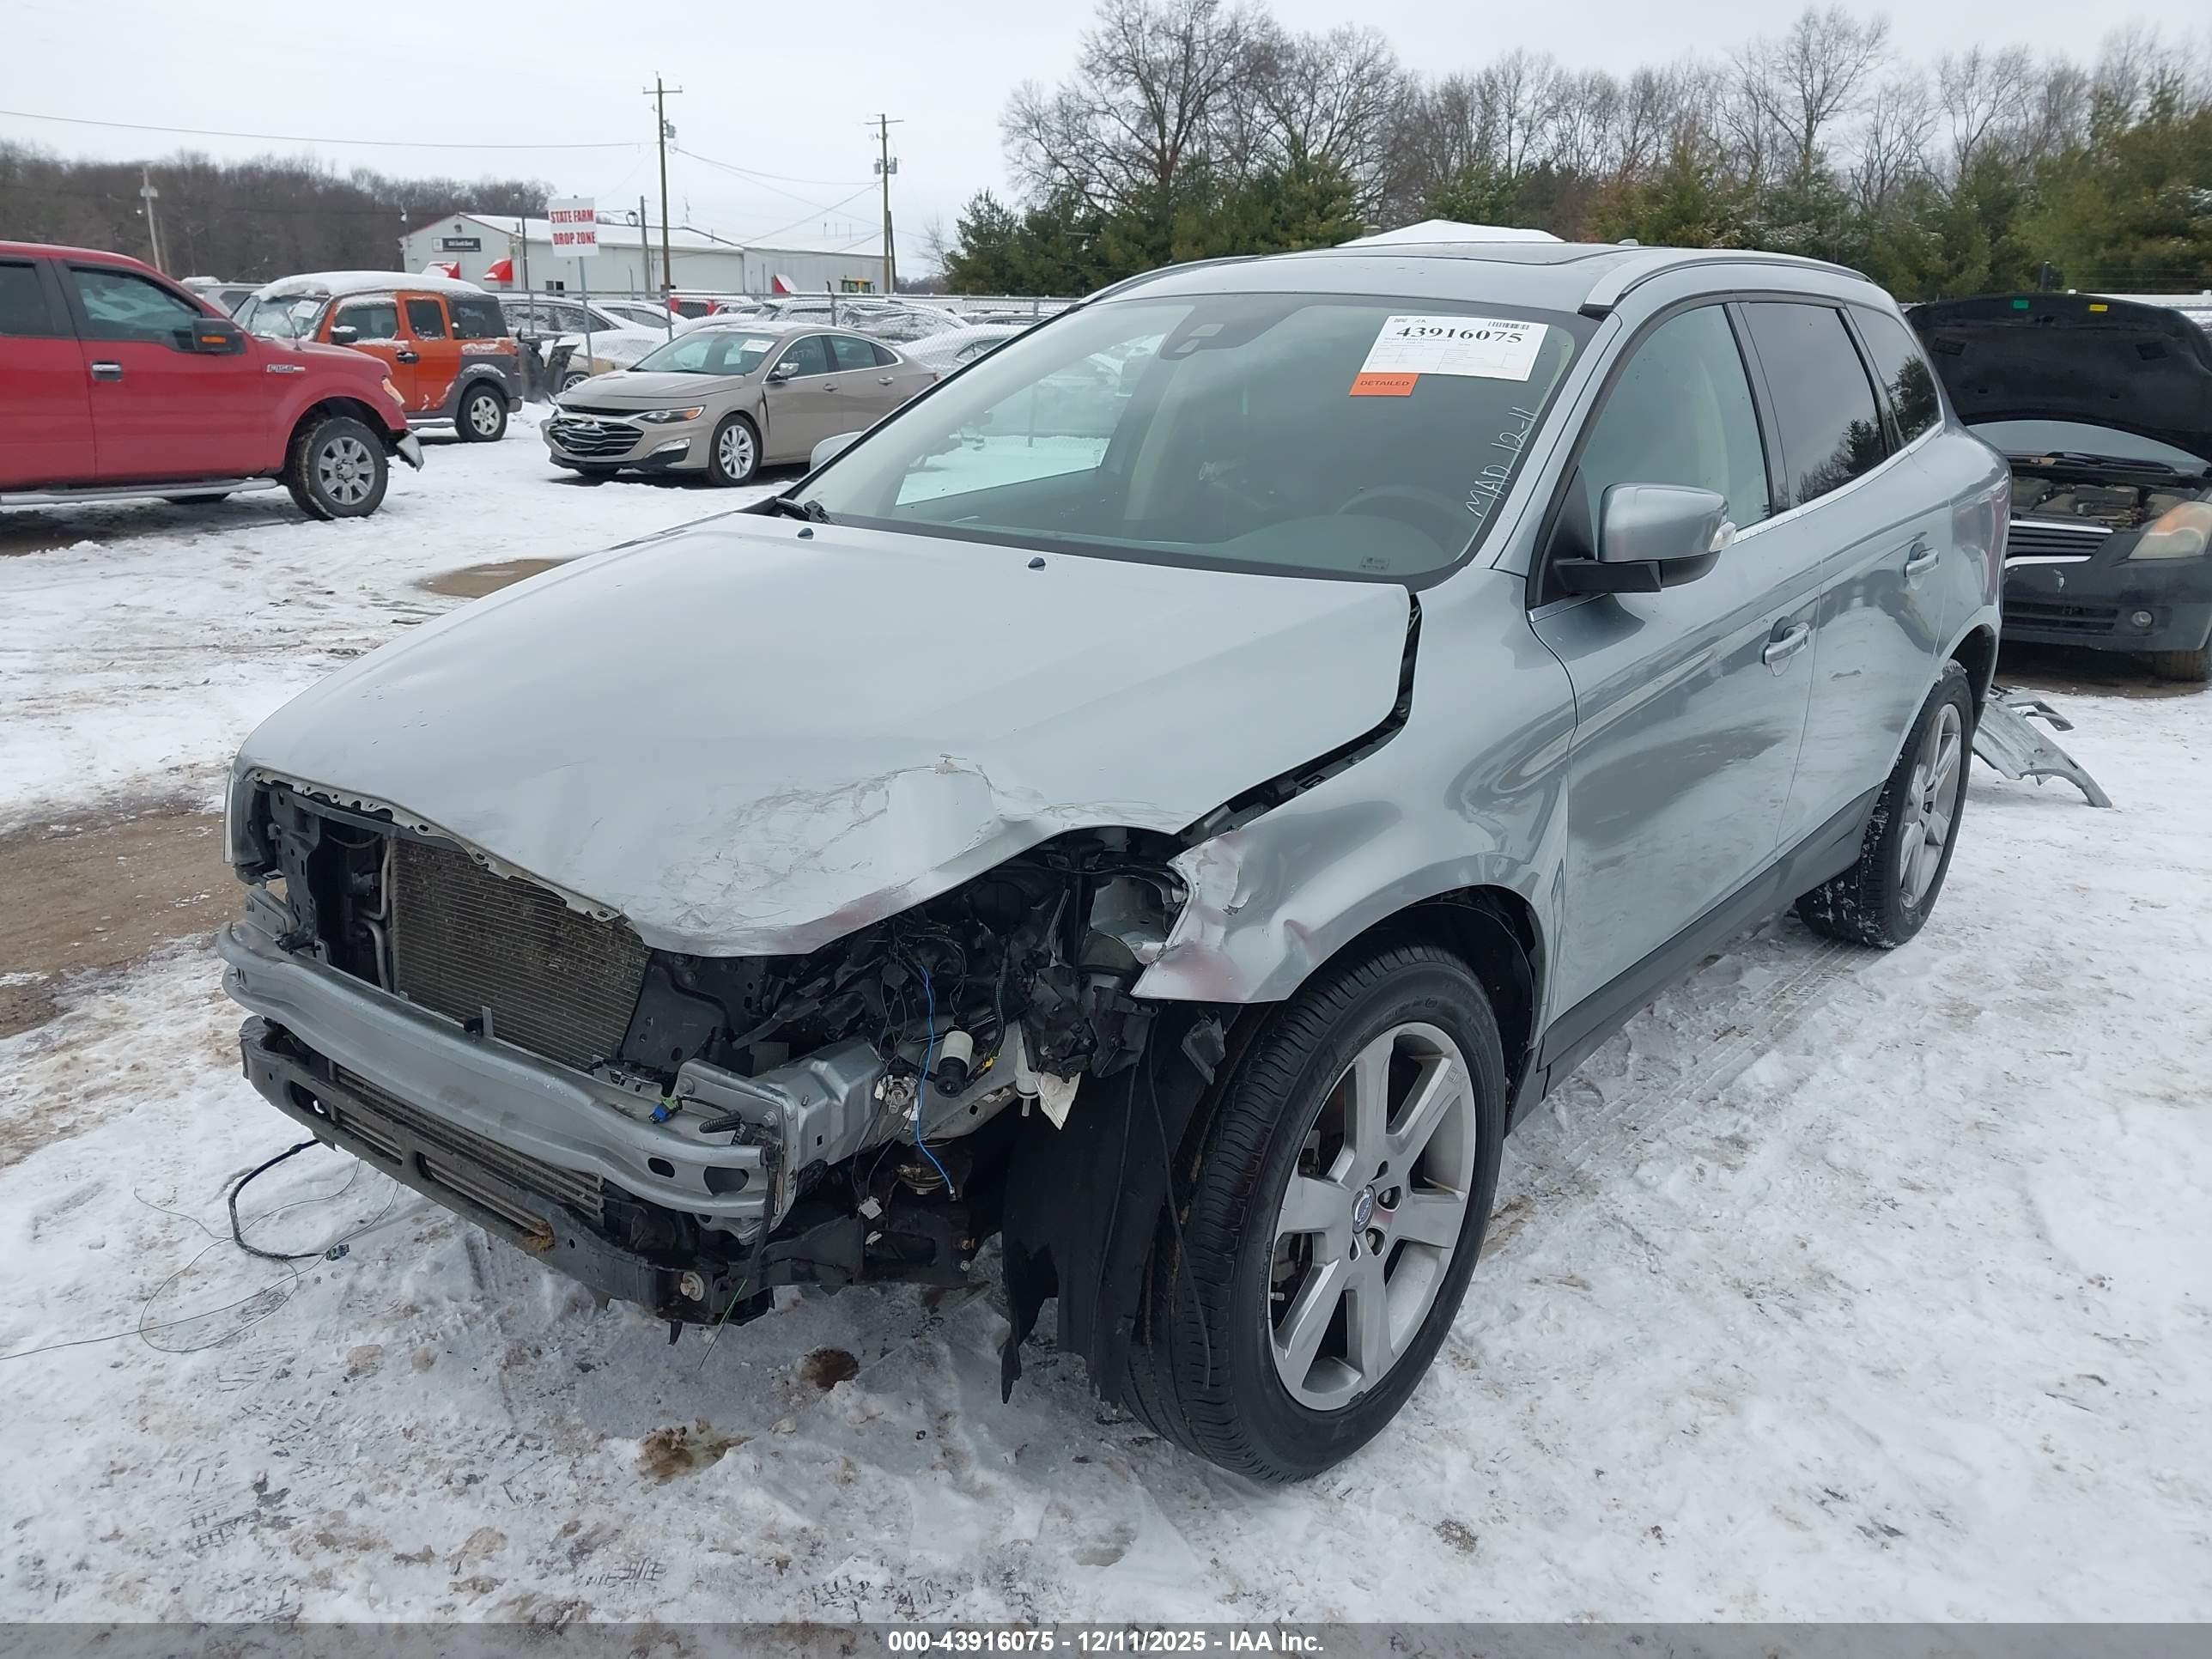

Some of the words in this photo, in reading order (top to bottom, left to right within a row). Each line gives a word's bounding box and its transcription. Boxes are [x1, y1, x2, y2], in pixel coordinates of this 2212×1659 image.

[550, 210, 572, 223] STATE
[574, 210, 593, 222] FARM
[553, 232, 574, 245] DROP
[576, 231, 595, 244] ZONE
[1396, 326, 1524, 343] 43916075
[1465, 465, 1511, 518] MAD
